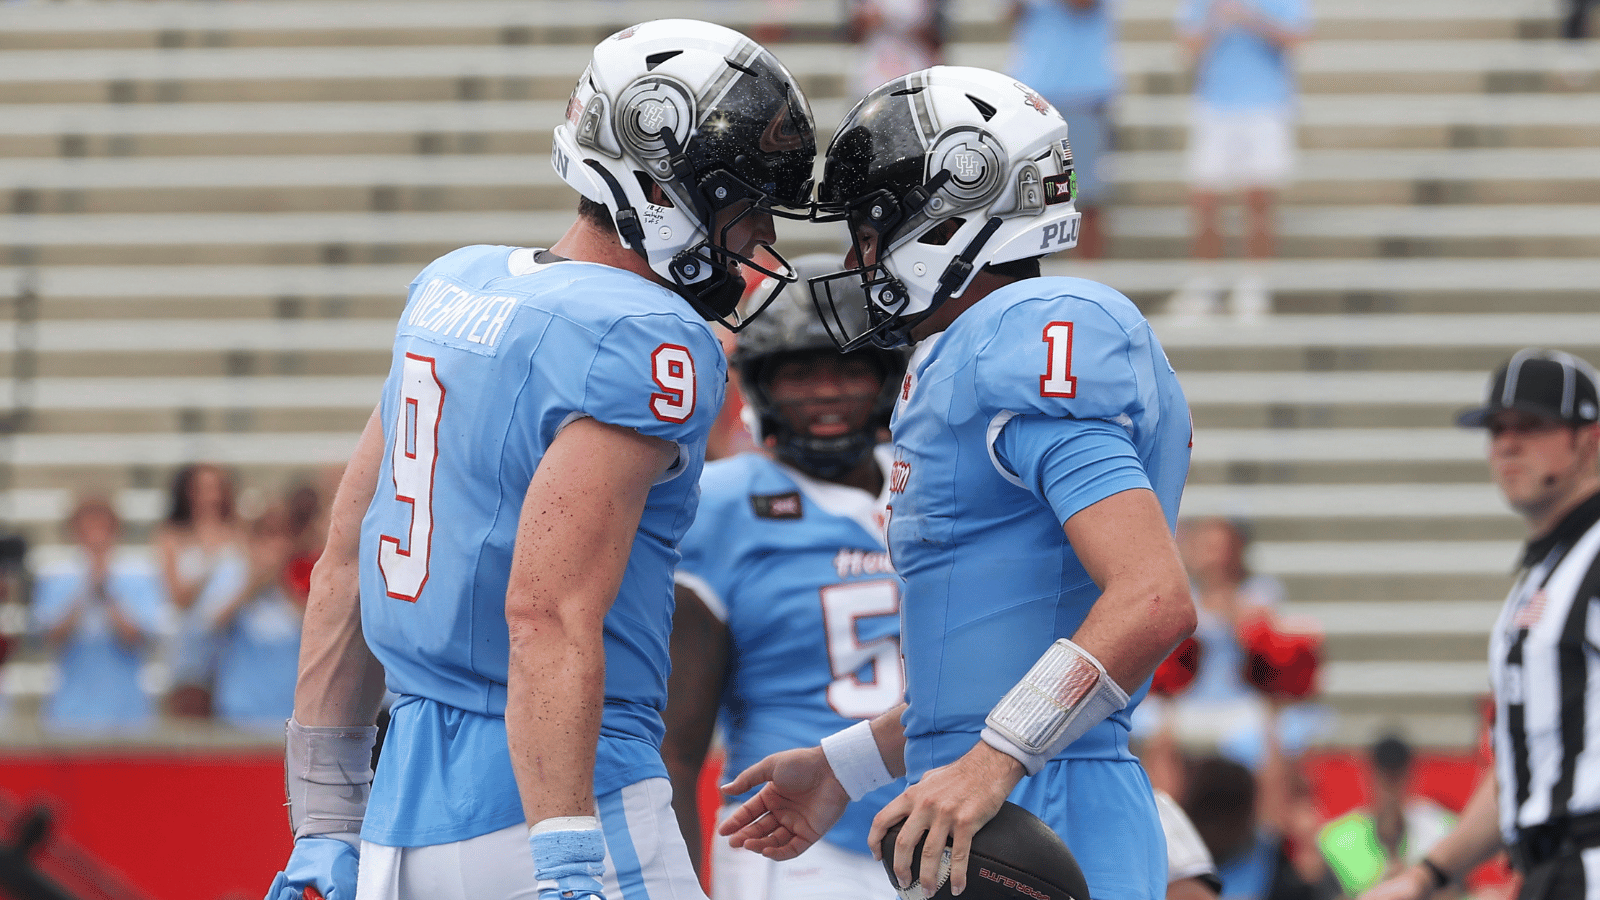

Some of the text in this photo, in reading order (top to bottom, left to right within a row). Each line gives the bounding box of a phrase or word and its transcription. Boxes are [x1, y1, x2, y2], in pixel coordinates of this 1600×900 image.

[408, 278, 518, 348] OVERMYER
[649, 343, 697, 424] 9
[1040, 321, 1077, 398] 1
[378, 352, 446, 603] 9
[820, 578, 902, 718] 5
[979, 867, 1017, 889] ELITE
